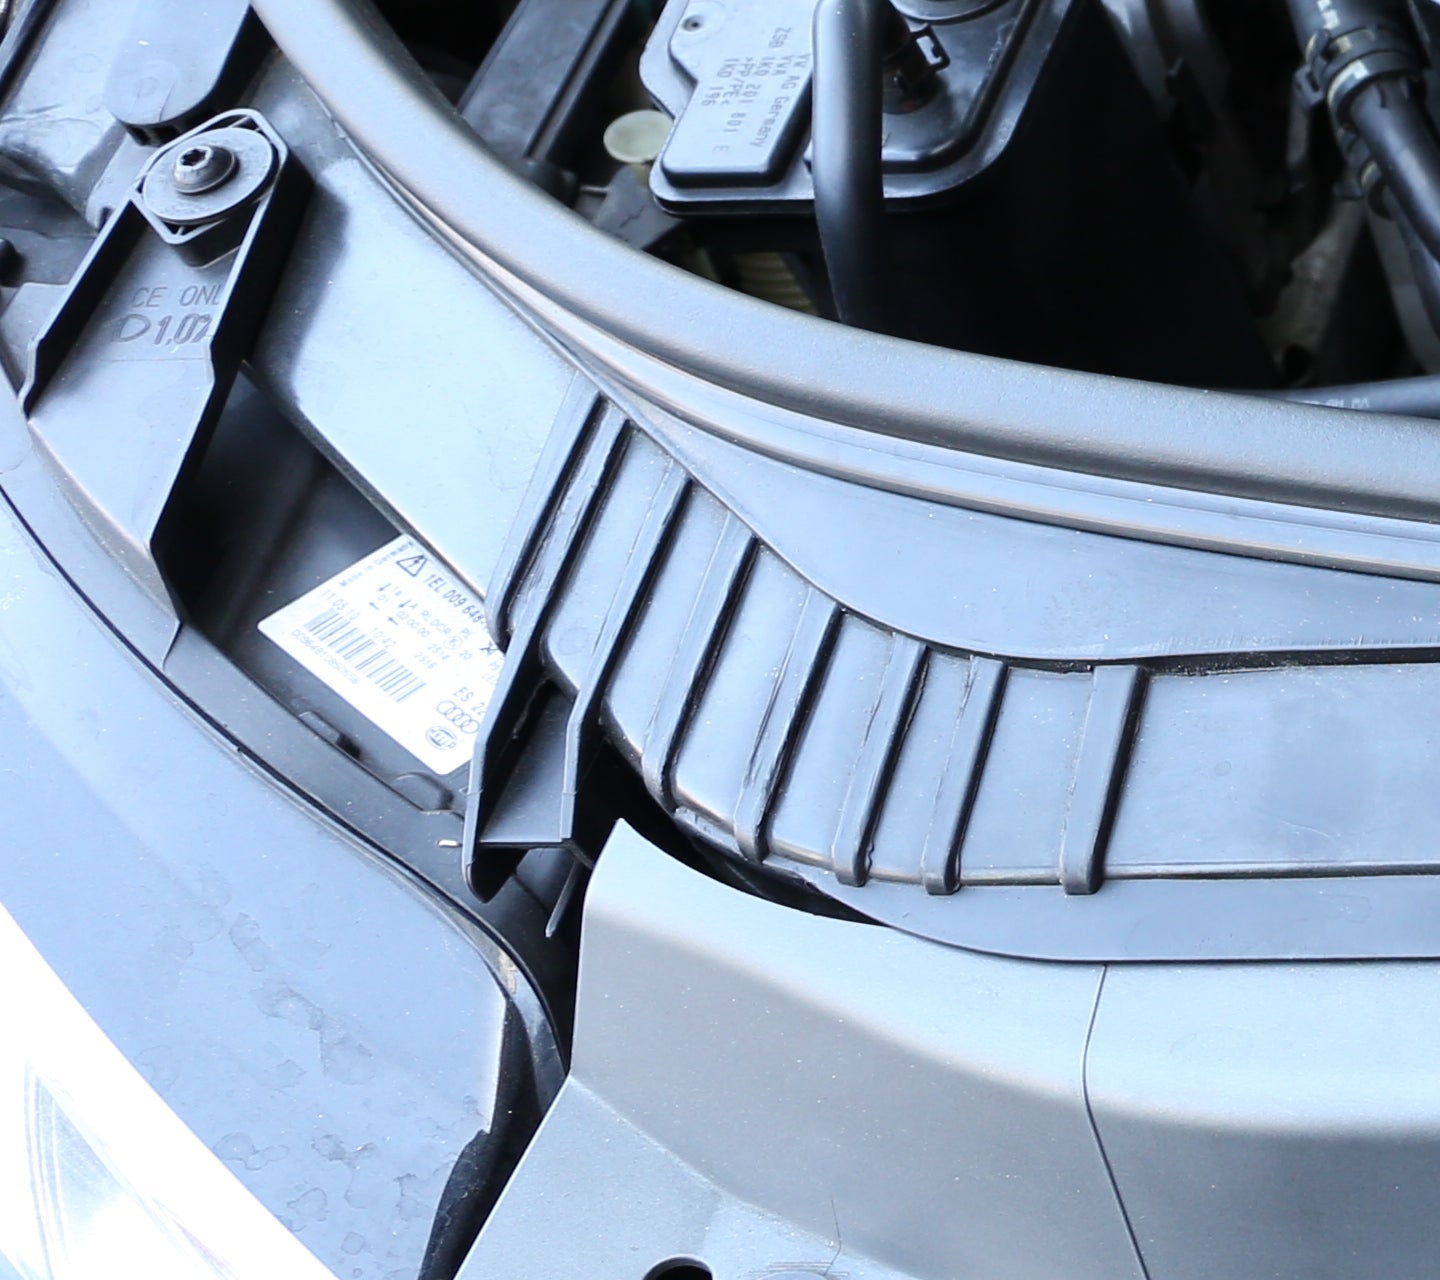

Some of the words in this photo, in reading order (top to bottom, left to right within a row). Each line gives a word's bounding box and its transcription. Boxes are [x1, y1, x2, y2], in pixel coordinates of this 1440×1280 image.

[781, 75, 801, 90] AG
[749, 96, 791, 149] Germany
[423, 573, 446, 592] 1EL
[442, 589, 465, 607] 009
